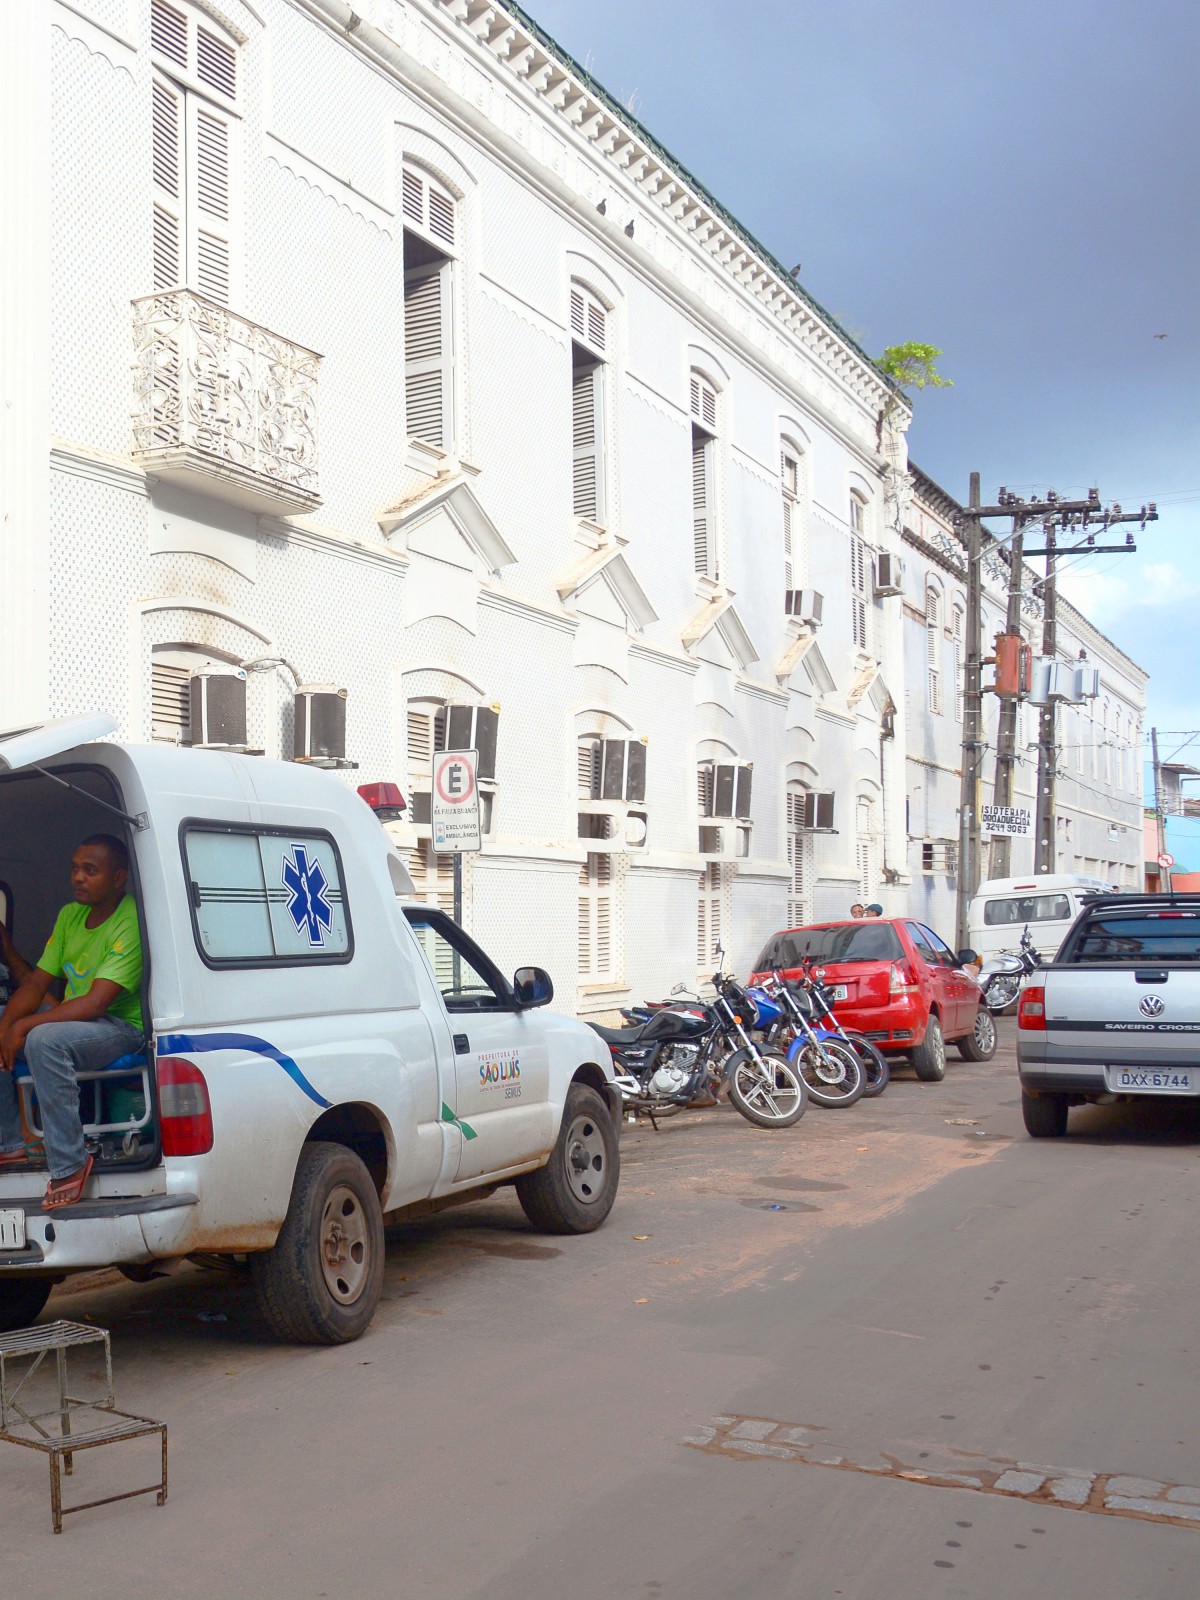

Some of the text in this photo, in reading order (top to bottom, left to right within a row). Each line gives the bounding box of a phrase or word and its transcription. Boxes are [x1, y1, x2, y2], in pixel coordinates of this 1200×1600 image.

[449, 767, 461, 793] E
[981, 805, 1031, 818] ISIOTERAPIA
[445, 831, 478, 839] AMBULÂNCIA
[478, 1051, 510, 1061] PREFEITURA
[480, 1056, 520, 1085] SÃO LUÍS
